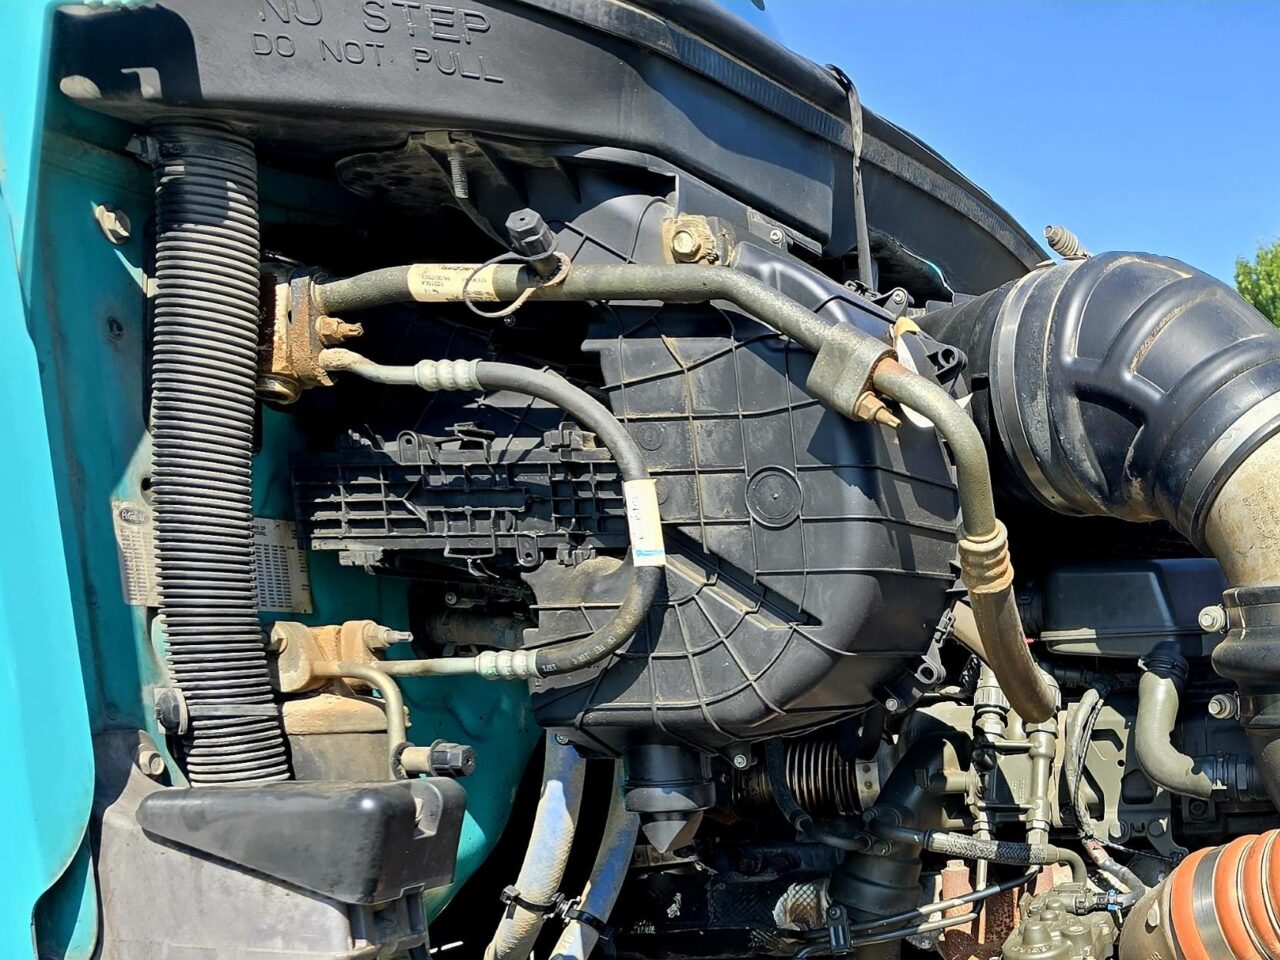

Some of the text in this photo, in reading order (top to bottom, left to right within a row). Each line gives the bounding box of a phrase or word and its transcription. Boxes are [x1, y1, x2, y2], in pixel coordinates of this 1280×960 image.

[258, 0, 491, 45] NO STEP
[252, 33, 504, 83] DO NOT PULL
